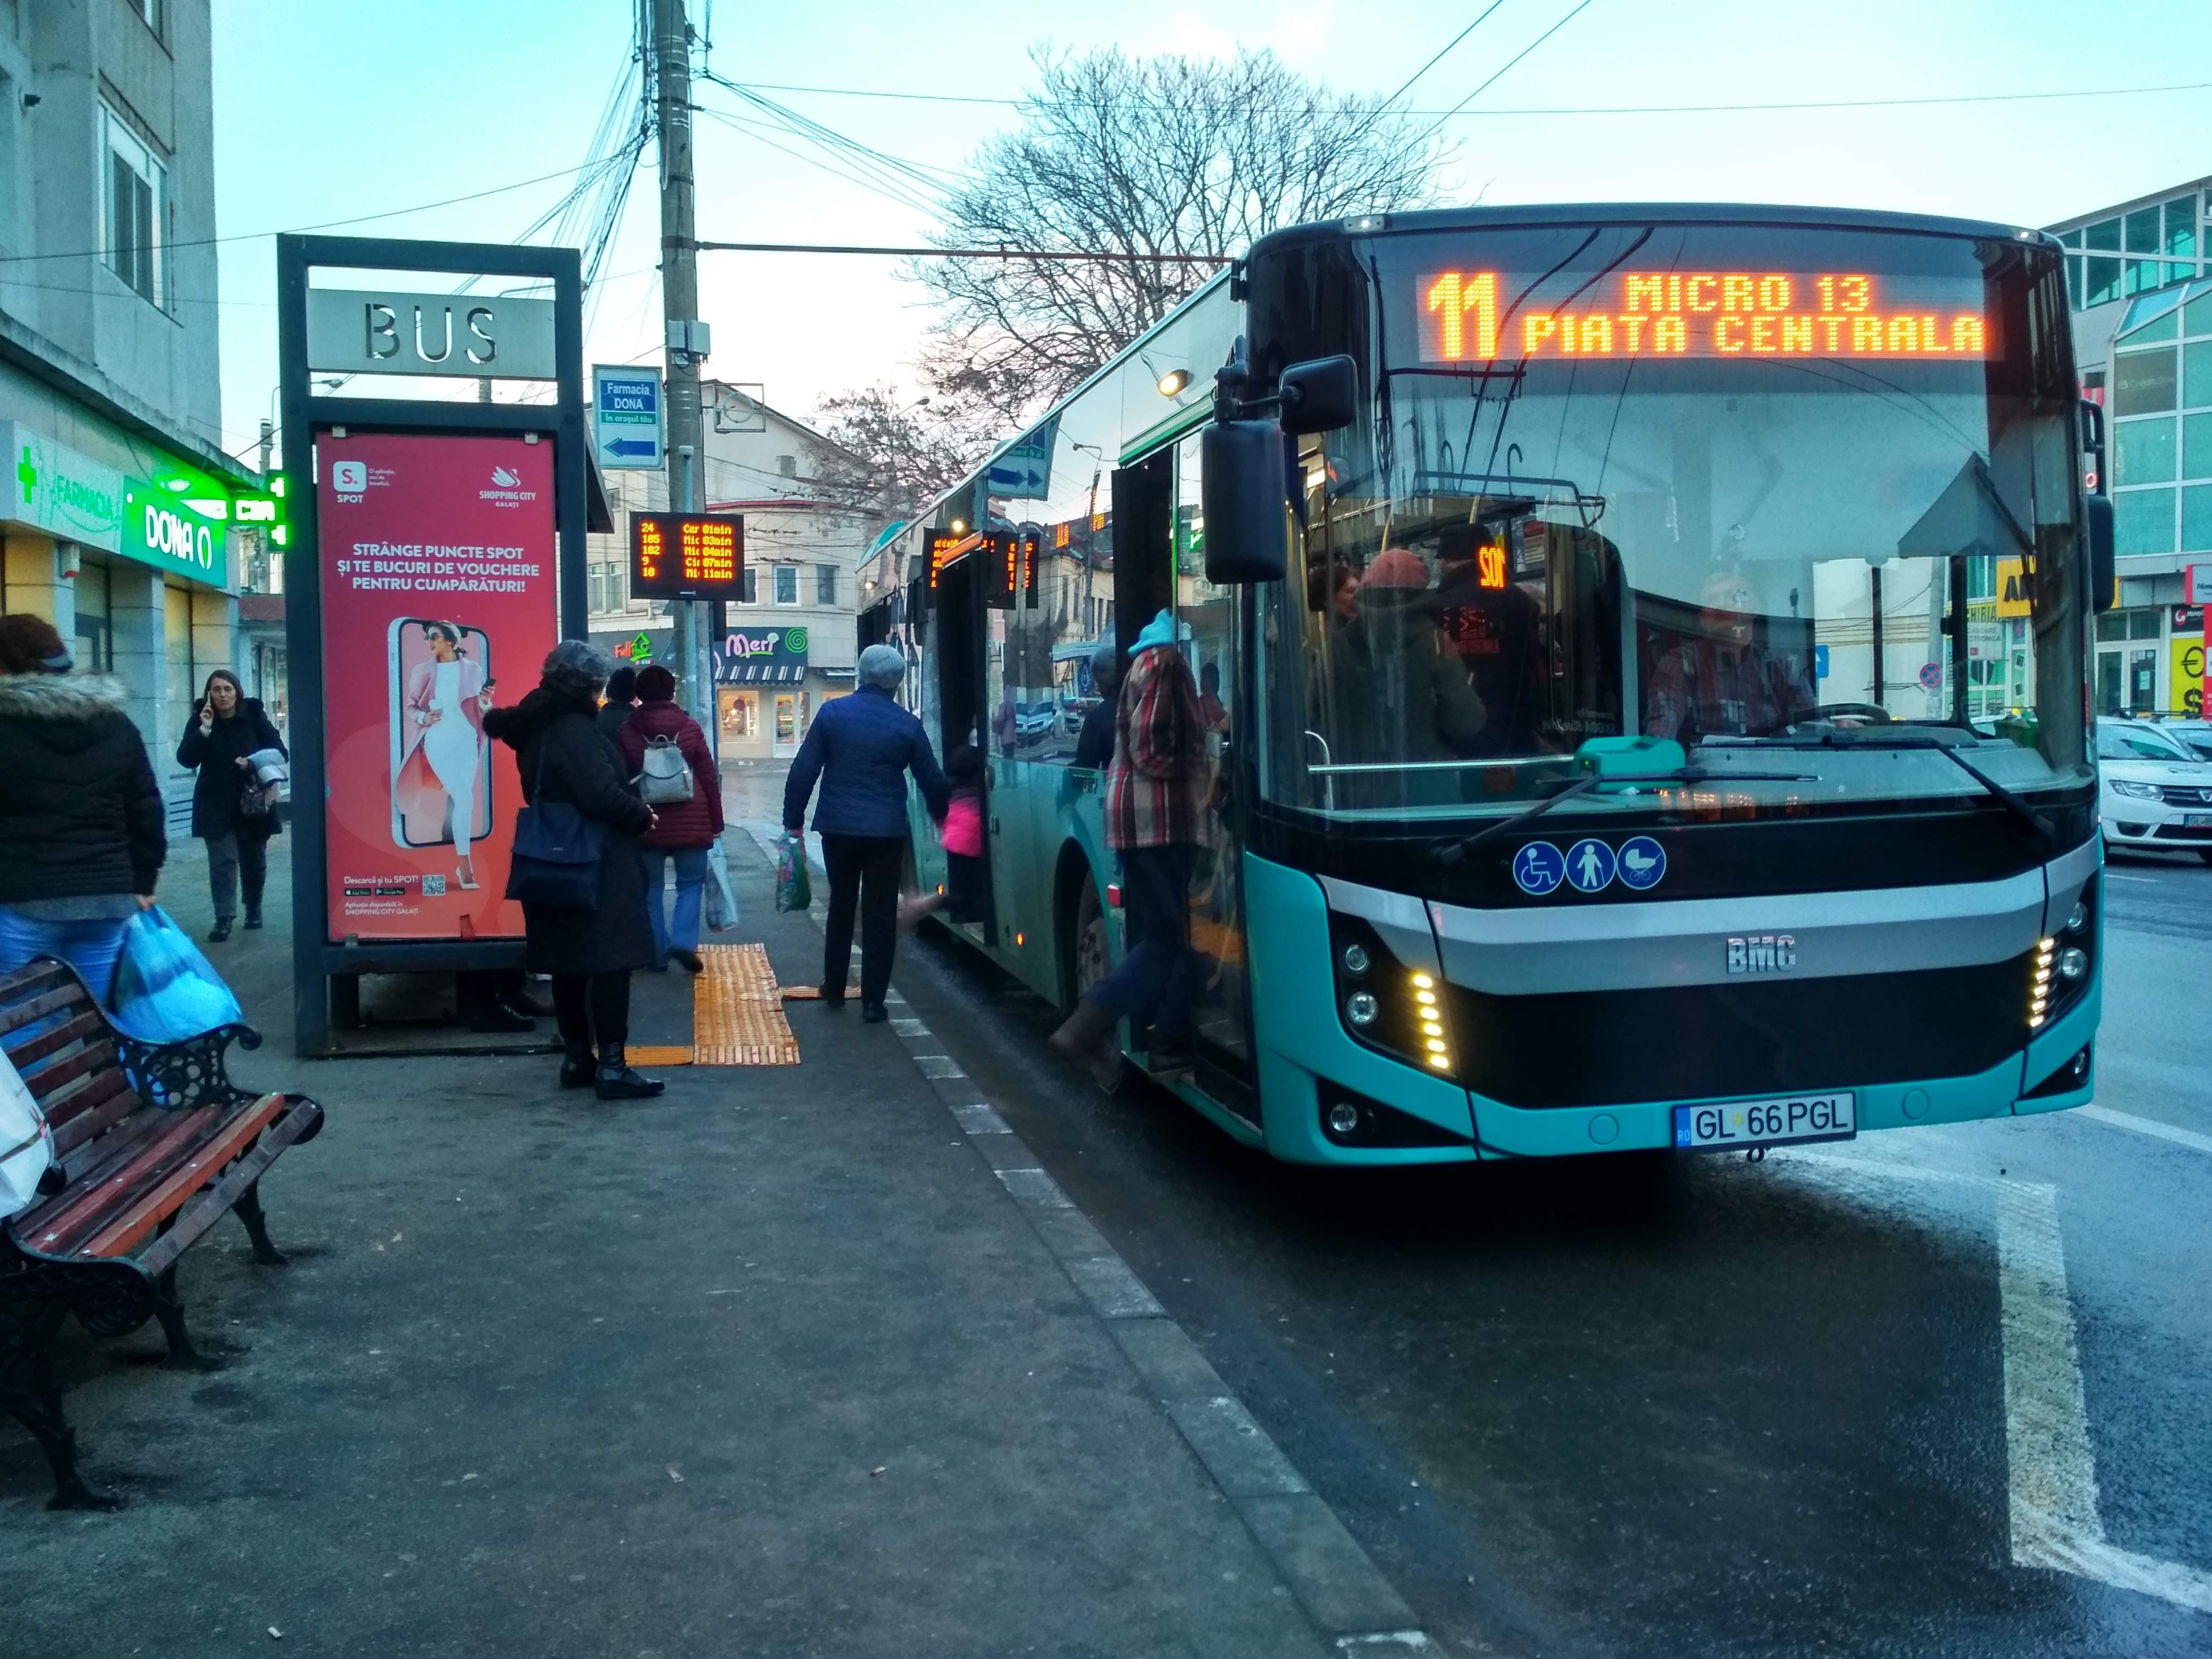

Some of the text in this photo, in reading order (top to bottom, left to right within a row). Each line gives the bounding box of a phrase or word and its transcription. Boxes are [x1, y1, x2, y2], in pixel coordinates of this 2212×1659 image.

[1627, 275, 1871, 313] MICRO 13
[1429, 273, 1496, 358] 11
[365, 303, 497, 365] BUS
[1524, 315, 1984, 353] PIATA CENTRALA
[607, 382, 650, 396] Farmacia
[614, 398, 644, 410] DONA
[640, 415, 653, 423] tău
[337, 495, 364, 503] SPOT
[479, 491, 537, 500] SHOPPING CITY
[145, 505, 194, 562] DONA
[641, 523, 655, 532] 24
[702, 525, 732, 534] 01min
[642, 534, 660, 543] 105
[702, 537, 732, 546] 03min
[353, 541, 524, 559] STRÂNGE PUNCTE SPOT
[642, 546, 660, 555] 102
[702, 548, 732, 557] 04min
[337, 560, 540, 578] ȘI TE BUCURI DE VOUCHERE
[702, 558, 732, 567] 07min
[643, 567, 656, 576] 10
[703, 569, 732, 579] 11min
[353, 576, 526, 592] PENTRU CUMPĂRĂTURI!
[725, 632, 780, 659] Meri
[1727, 935, 1796, 974] BMC
[1696, 1109, 1735, 1139] GL
[1678, 1129, 1690, 1142] RO
